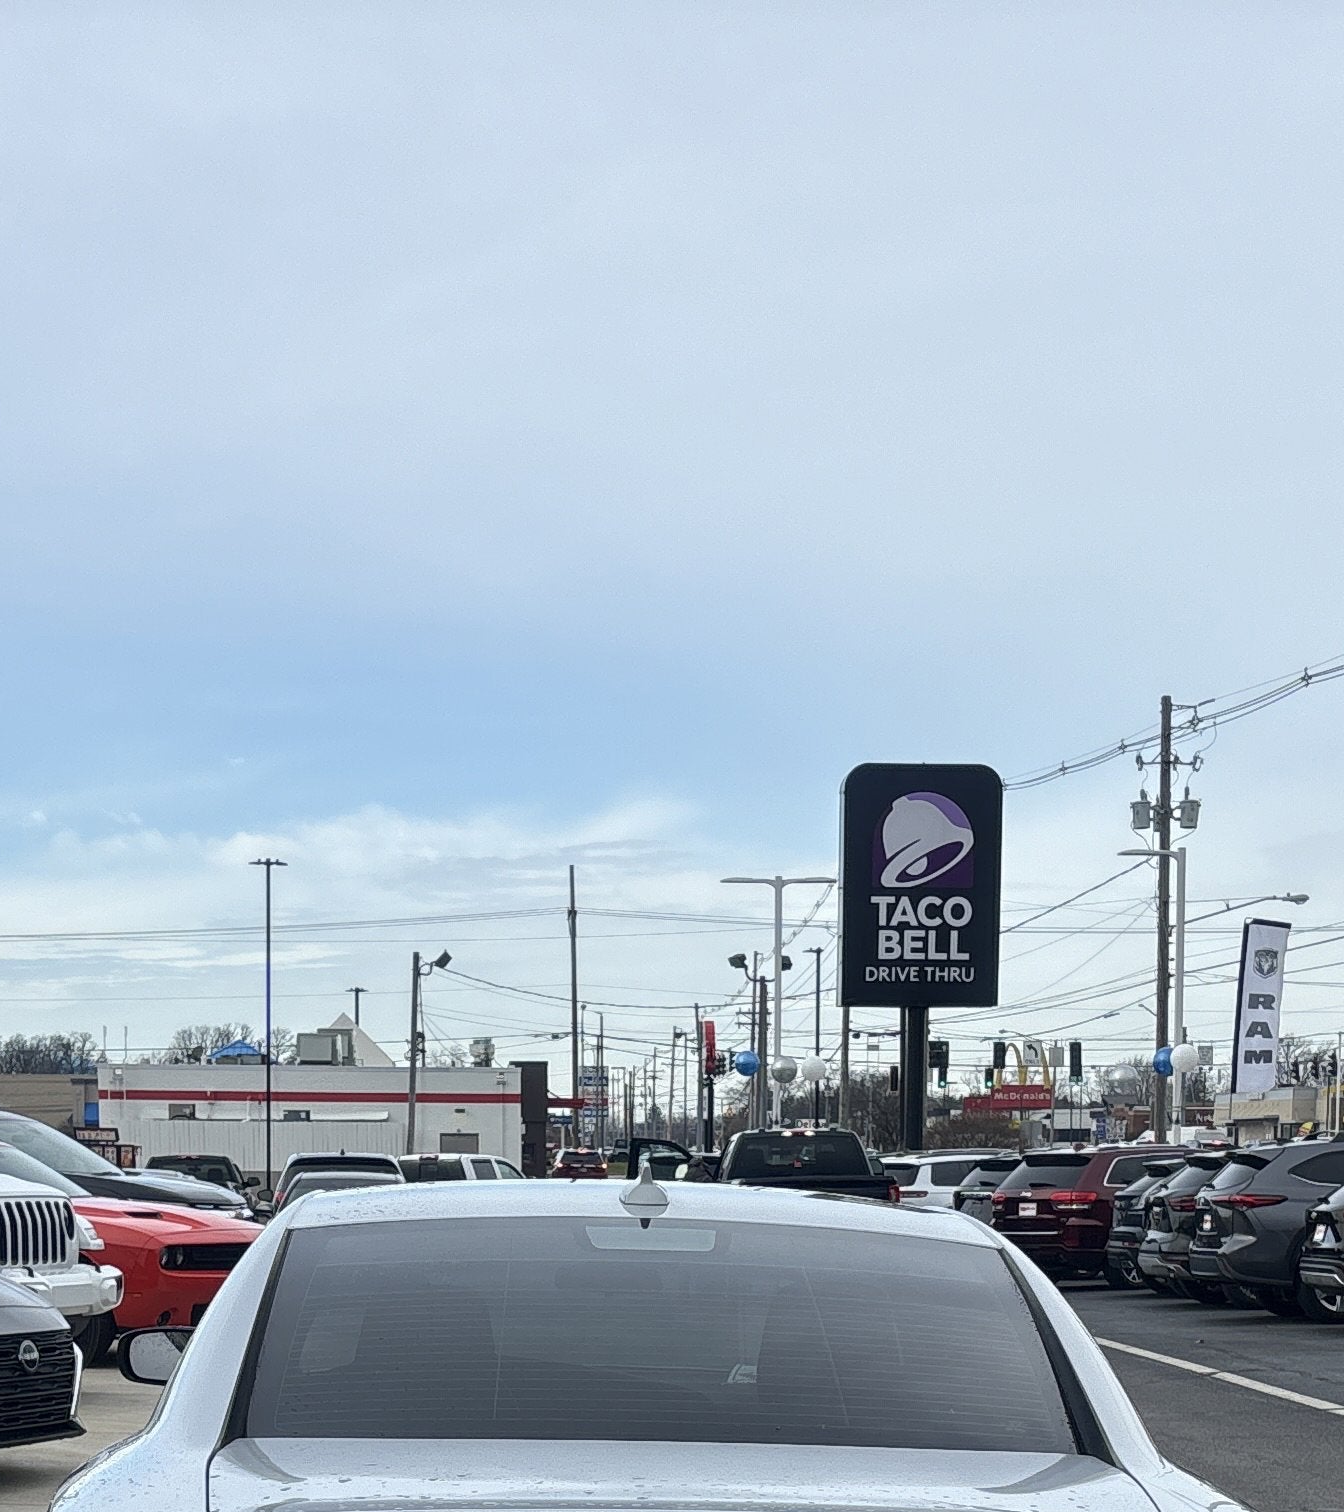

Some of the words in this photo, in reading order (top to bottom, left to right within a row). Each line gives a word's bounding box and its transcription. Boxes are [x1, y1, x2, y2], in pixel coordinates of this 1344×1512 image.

[870, 896, 973, 927] TACO
[878, 930, 970, 960] BELL
[865, 966, 920, 982] DRIVE
[924, 966, 975, 982] THRU
[1244, 993, 1275, 1064] RAM
